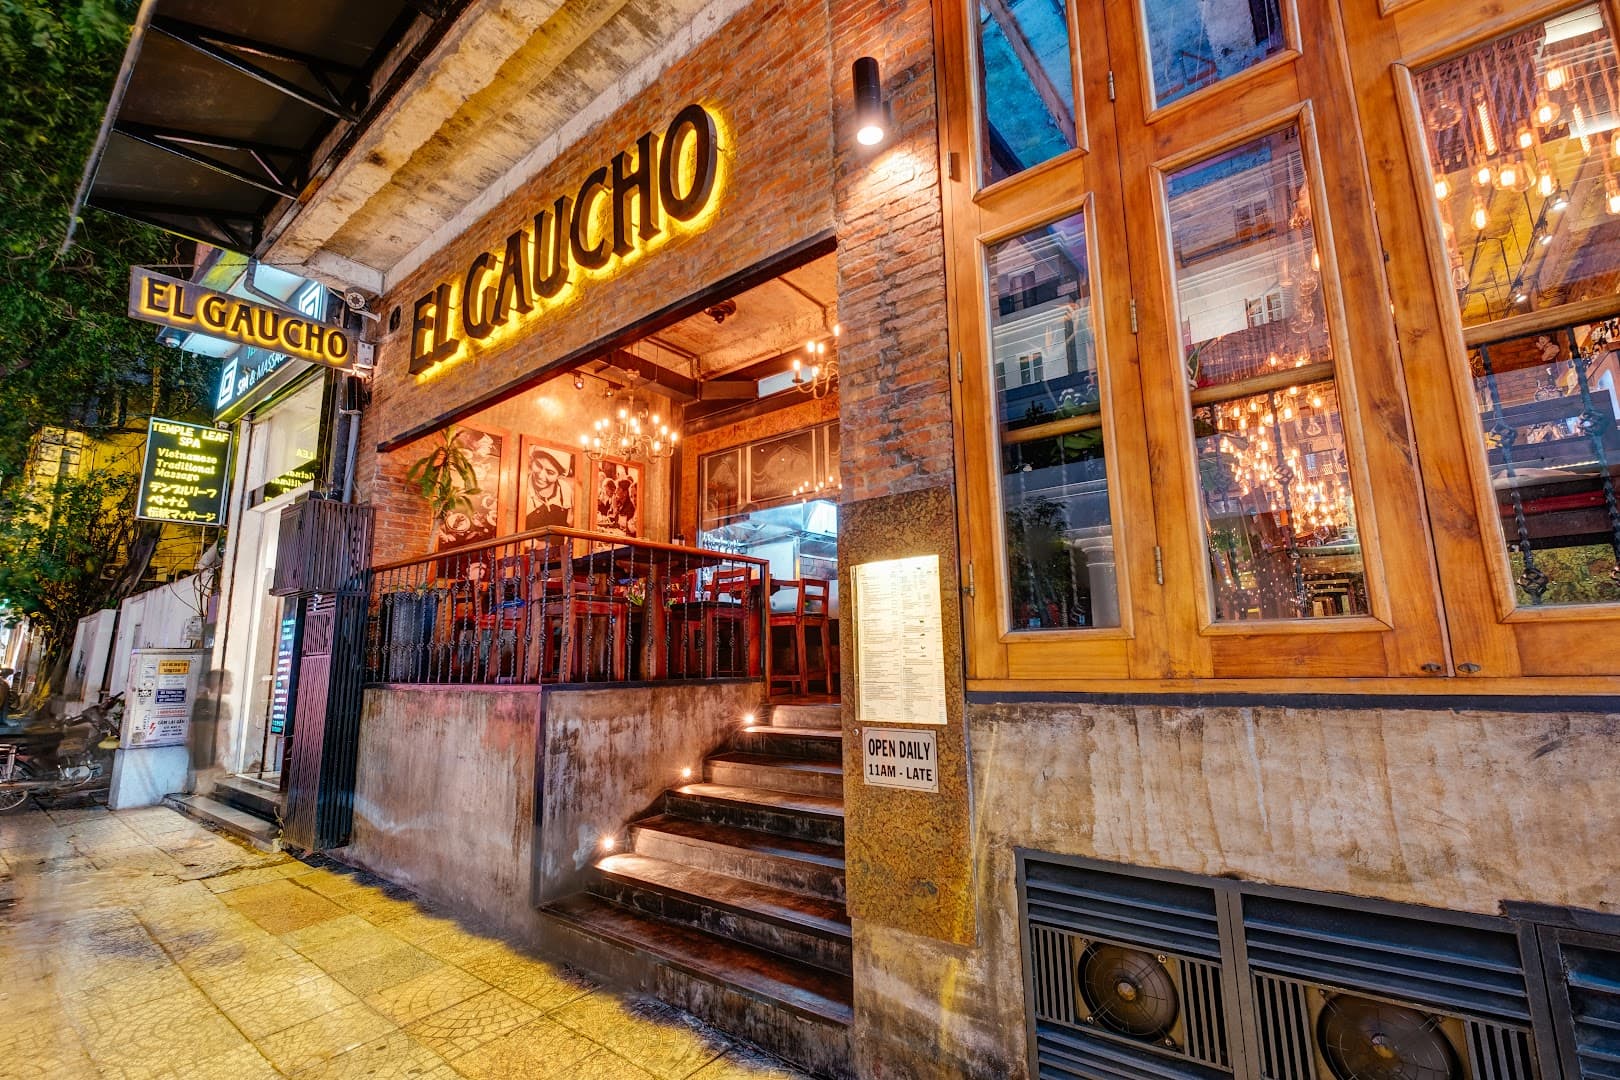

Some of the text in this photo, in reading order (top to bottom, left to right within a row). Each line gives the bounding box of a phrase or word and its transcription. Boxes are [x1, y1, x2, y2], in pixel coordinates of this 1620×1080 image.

[408, 104, 717, 375] EL GAUCHO
[146, 277, 348, 358] EL GAUCHO
[153, 422, 229, 443] TEMPLE LEAF
[179, 436, 201, 448] SPA
[157, 448, 217, 464] Vietnamese
[154, 468, 200, 481] Massage
[156, 459, 215, 475] Traditional
[868, 738, 930, 760] OPEN DAILY
[868, 763, 896, 778] 11AM
[906, 766, 933, 781] LATE
